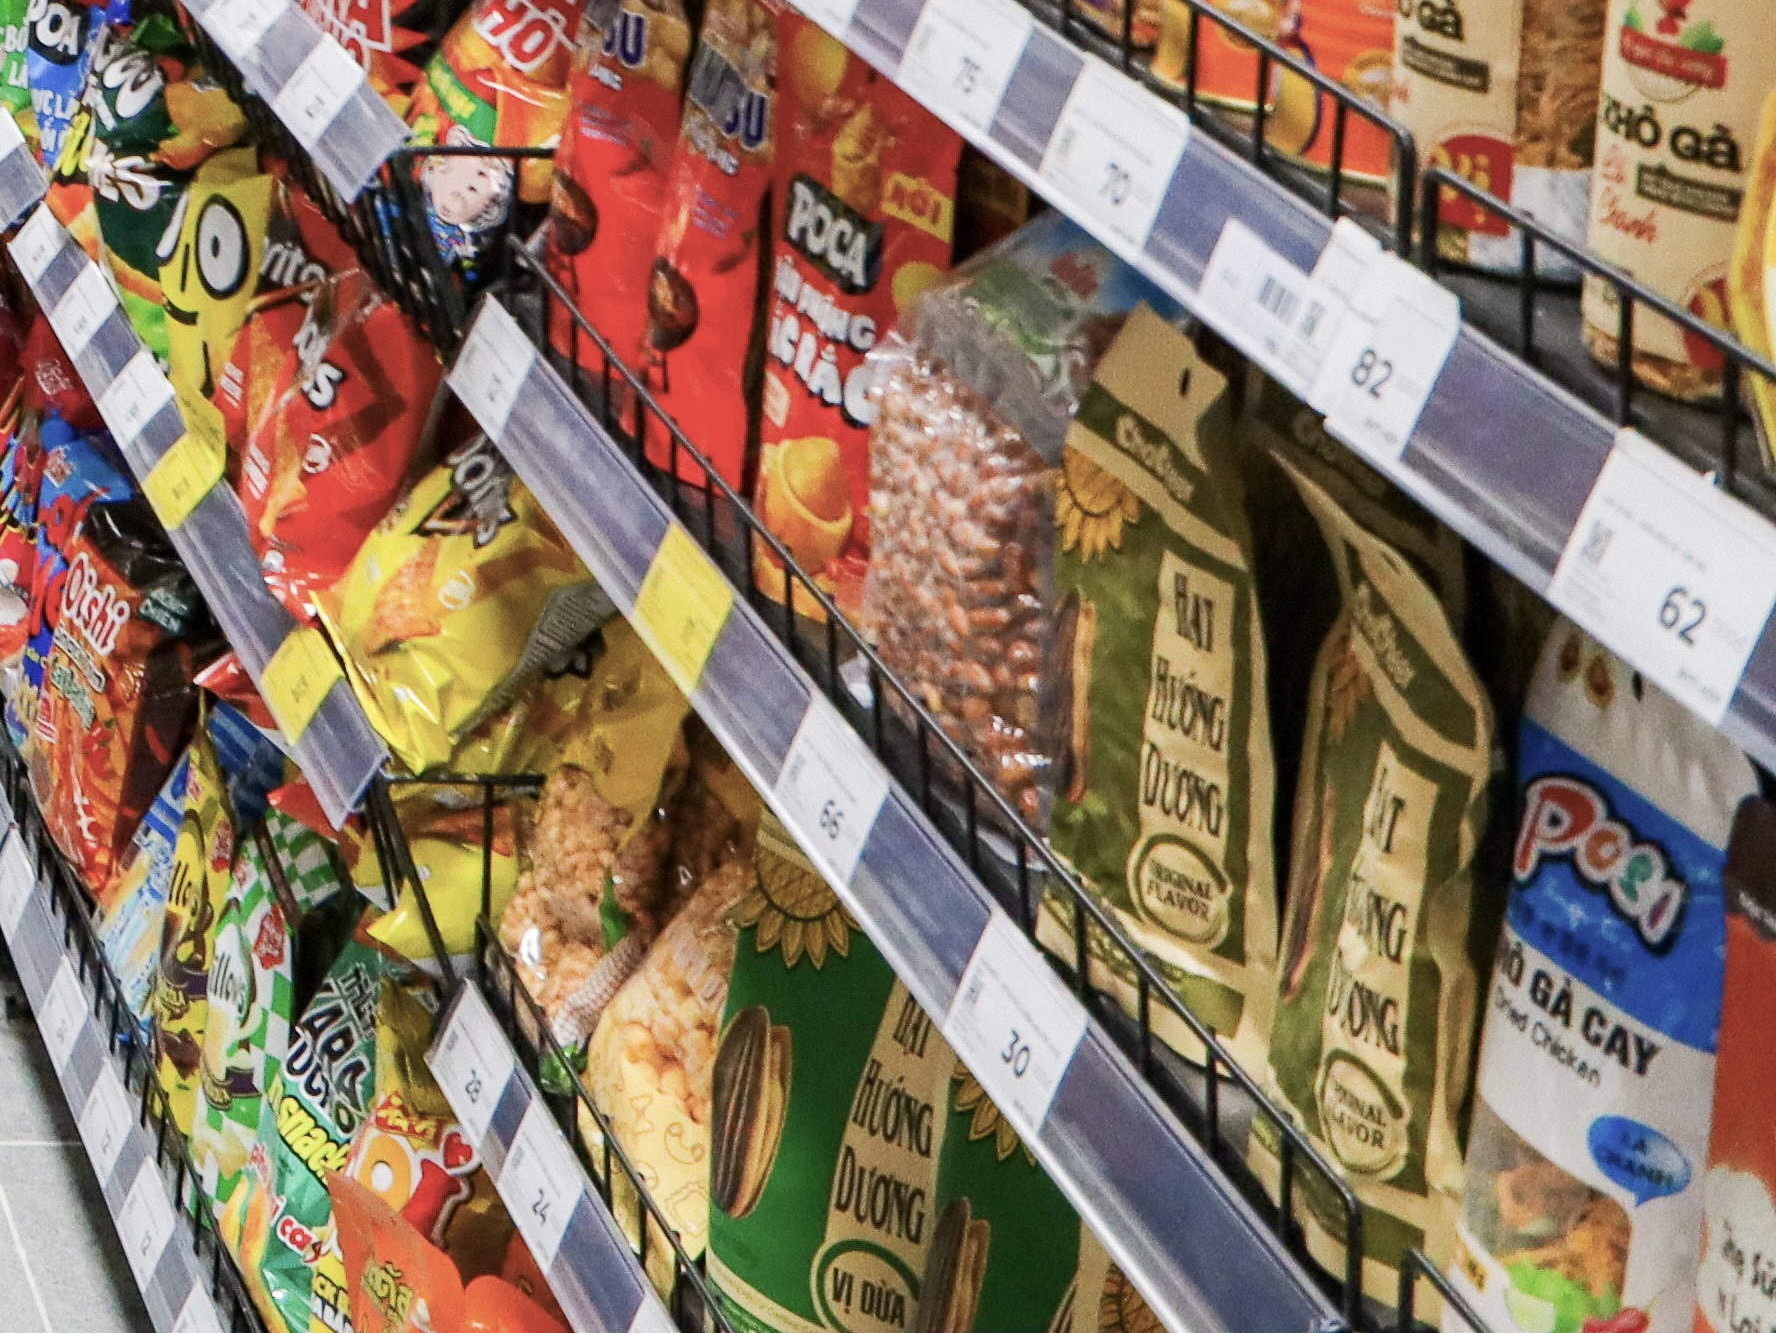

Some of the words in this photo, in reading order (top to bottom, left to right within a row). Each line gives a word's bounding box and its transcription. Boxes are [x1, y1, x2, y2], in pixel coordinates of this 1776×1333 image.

[956, 56, 981, 95] 75
[1100, 162, 1130, 207] 70
[787, 181, 868, 289] POCA
[1351, 348, 1393, 399] 82
[64, 553, 121, 655] Oishi
[1173, 571, 1216, 655] HẠT
[1659, 587, 1706, 646] 62
[1150, 658, 1228, 752] HƯỚNG
[820, 800, 844, 840] 66
[1142, 741, 1225, 839] DƯƠNG
[1145, 880, 1214, 926] FLAVOR
[1528, 959, 1577, 1032] GÀ
[1580, 1004, 1660, 1081] CAY
[1001, 1030, 1030, 1078] 30
[465, 1069, 481, 1104] 28
[857, 1058, 935, 1165] HƯỚNG
[532, 1189, 549, 1224] 24
[833, 1156, 930, 1246] DƯƠNG
[830, 1264, 861, 1310] VỊ
[861, 1273, 910, 1326] DỪA
